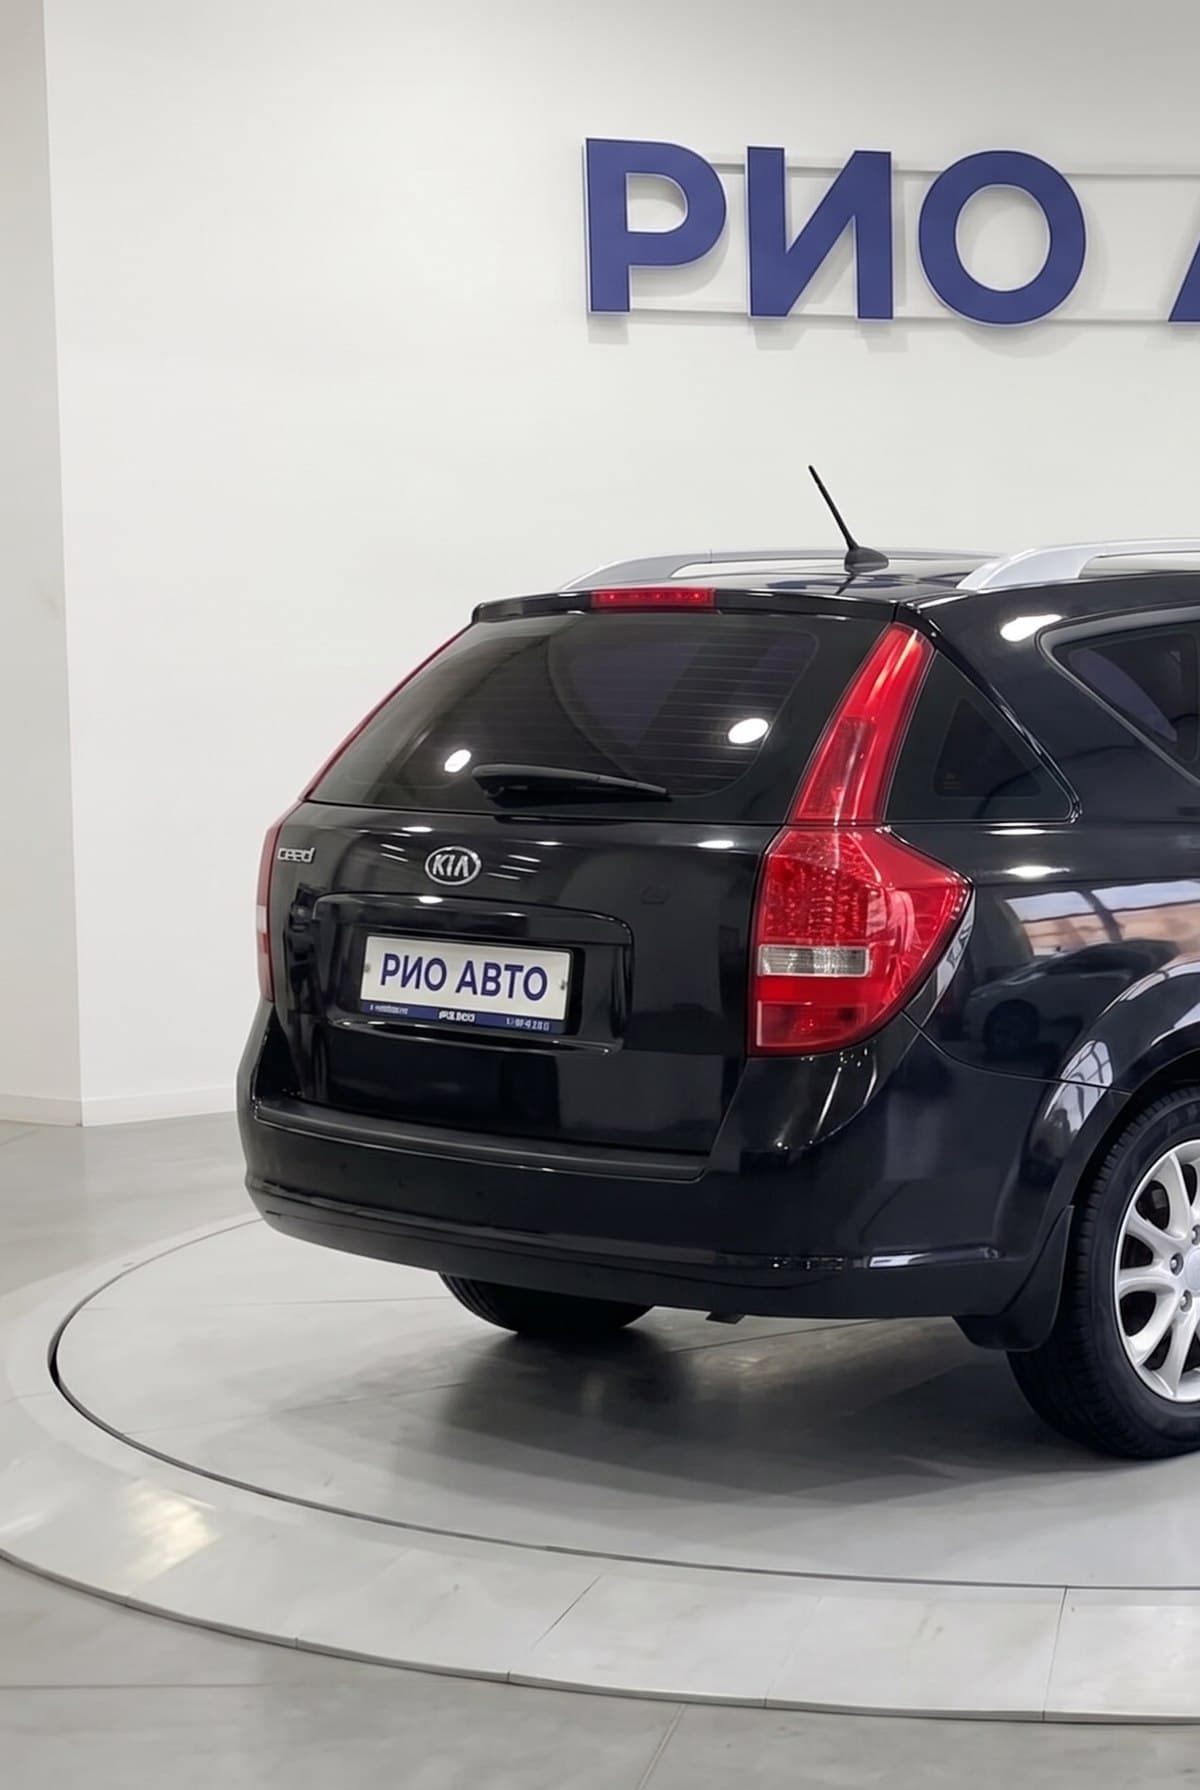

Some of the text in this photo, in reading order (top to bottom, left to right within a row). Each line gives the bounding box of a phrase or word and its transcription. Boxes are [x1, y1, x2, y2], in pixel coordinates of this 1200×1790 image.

[586, 139, 1086, 325] РИО
[432, 854, 469, 877] KIA
[380, 953, 548, 1001] РИО АВТО
